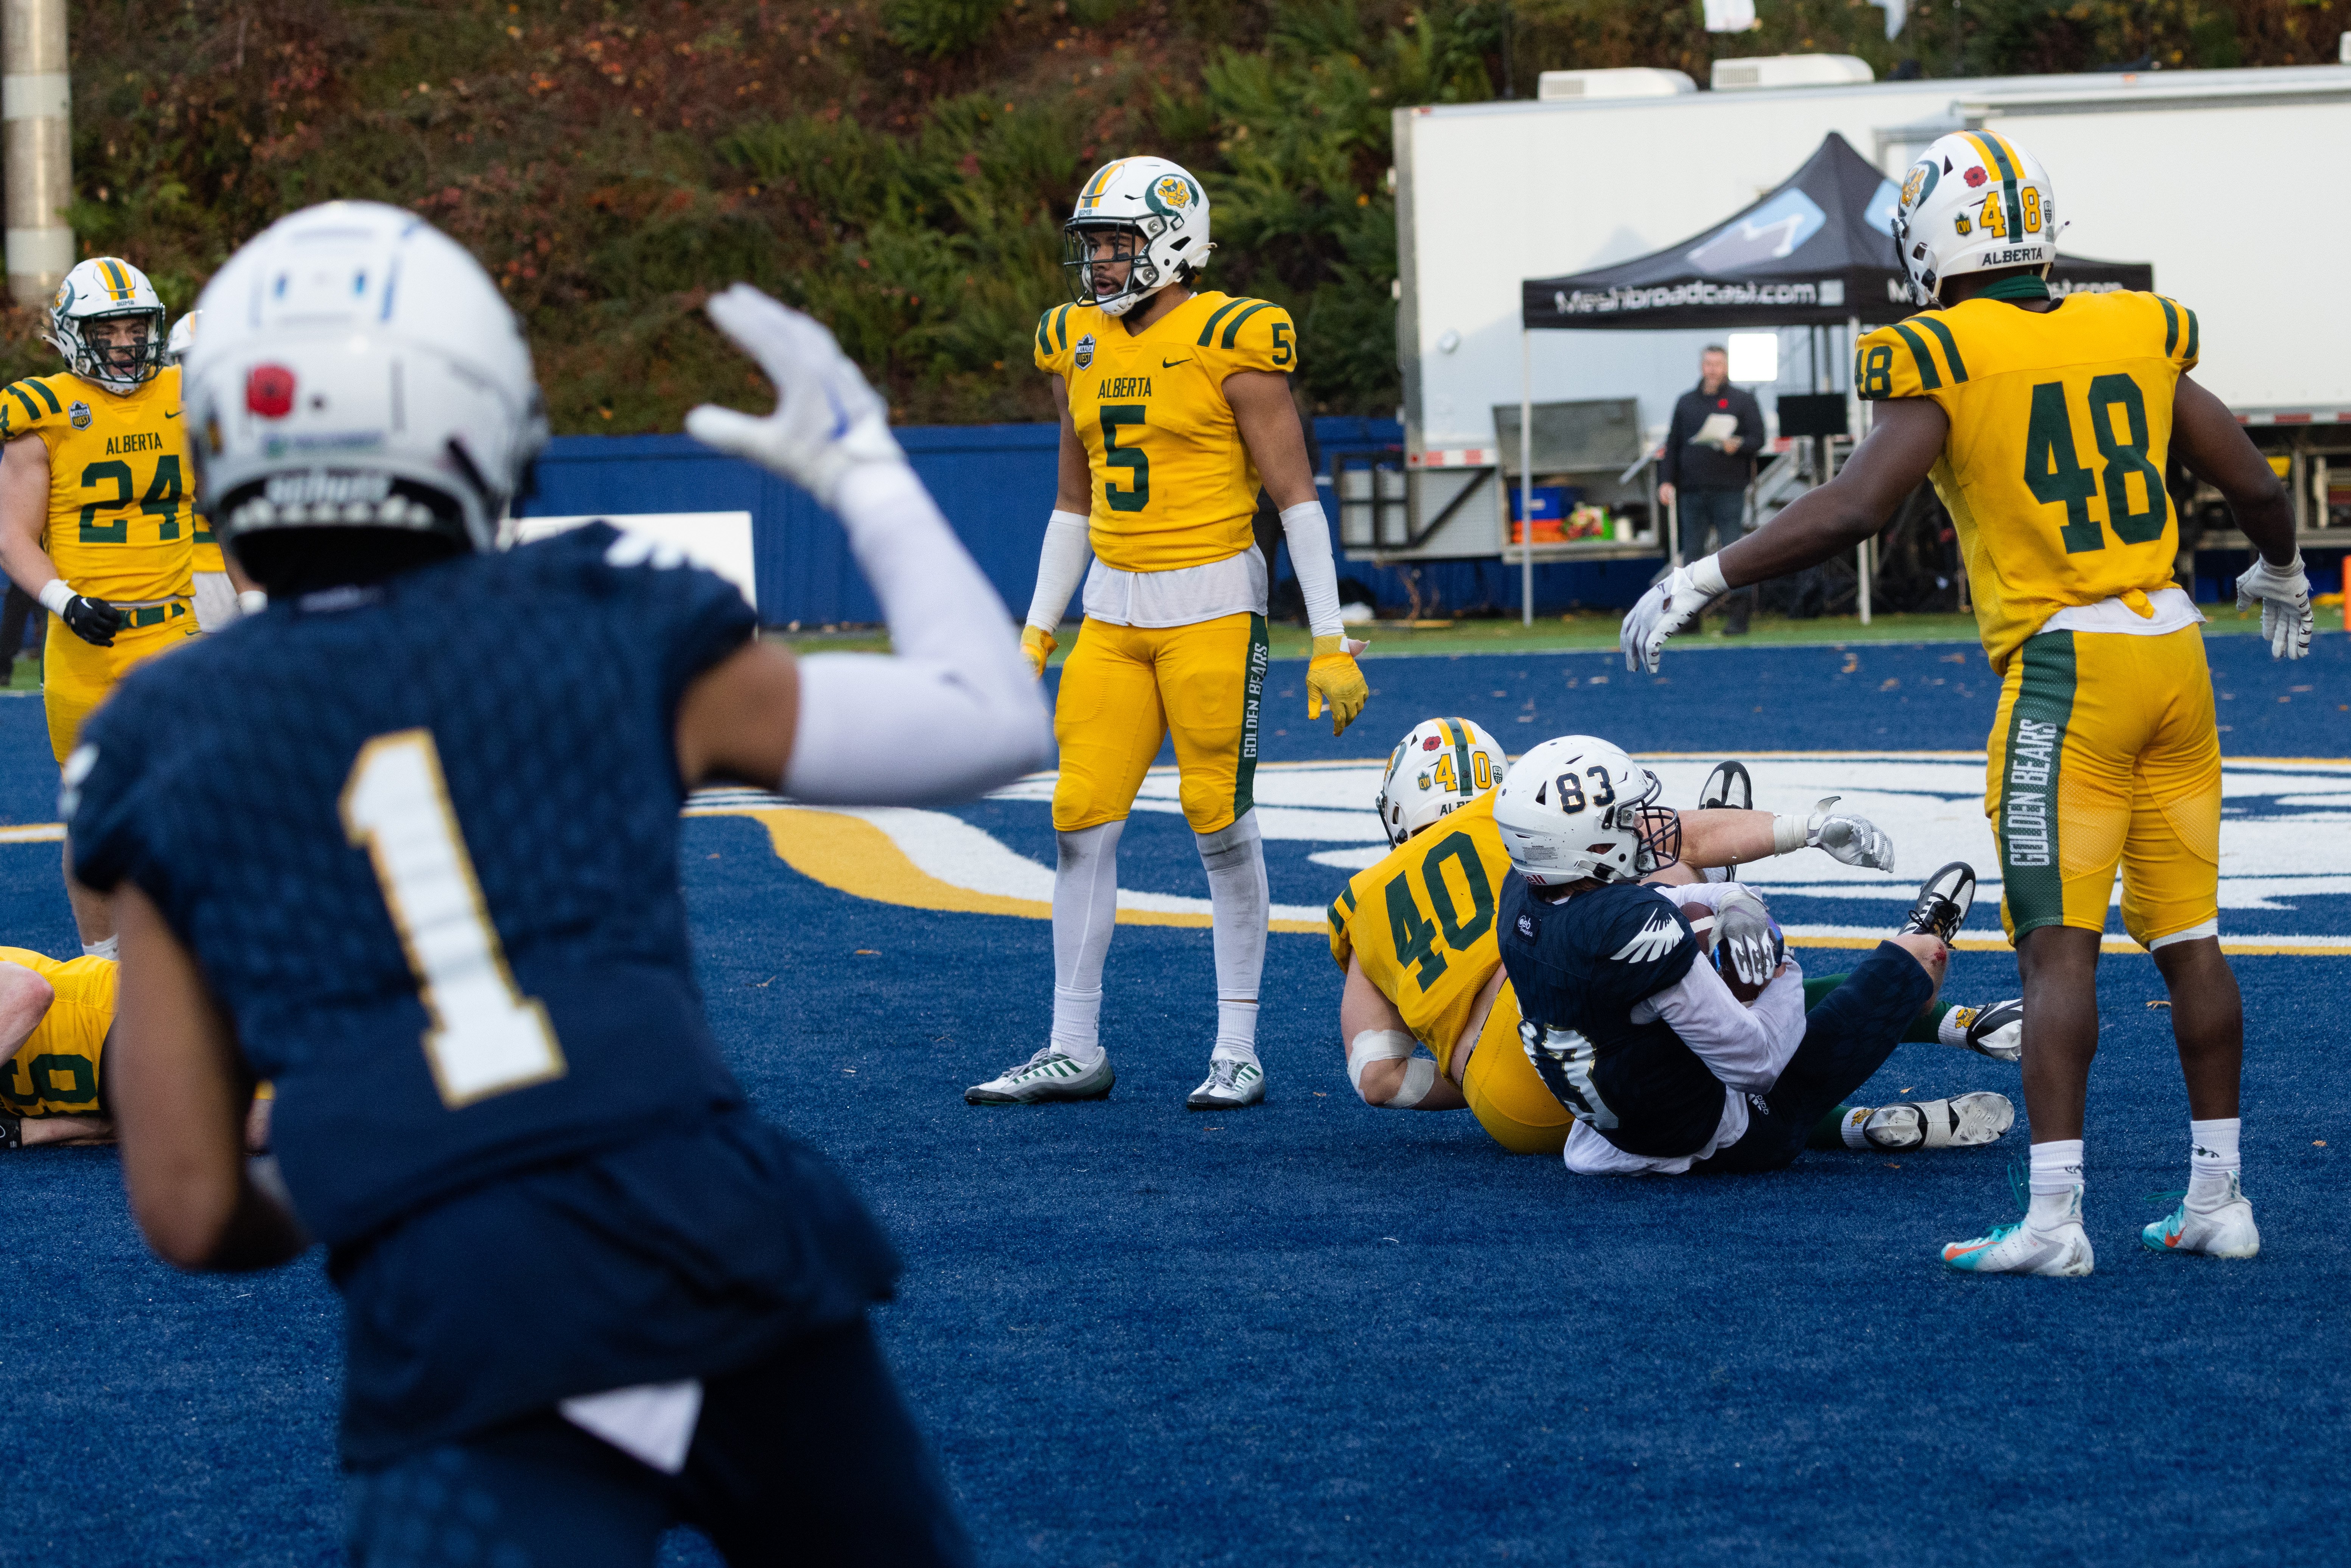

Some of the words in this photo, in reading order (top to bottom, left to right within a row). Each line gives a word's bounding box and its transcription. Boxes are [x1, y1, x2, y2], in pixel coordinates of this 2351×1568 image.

[1981, 247, 2043, 266] ALBERTA
[1077, 353, 1091, 363] WEST
[1271, 323, 1292, 365] 5
[1097, 377, 1152, 399] ALBERTA
[1855, 346, 1893, 400] 48
[106, 431, 163, 455] ALBERTA
[1099, 404, 1149, 512] 5
[2024, 373, 2167, 554] 48
[79, 454, 182, 544] 24
[1249, 642, 1267, 695] BEARS
[1244, 699, 1259, 757] GOLDEN
[2011, 719, 2057, 786] BEARS
[1434, 751, 1491, 792] 40
[1555, 765, 1616, 815] 83
[2007, 790, 2051, 866] GOLDEN
[1520, 872, 1548, 884] ell
[337, 726, 569, 1111] 1
[1385, 831, 1496, 993] 40
